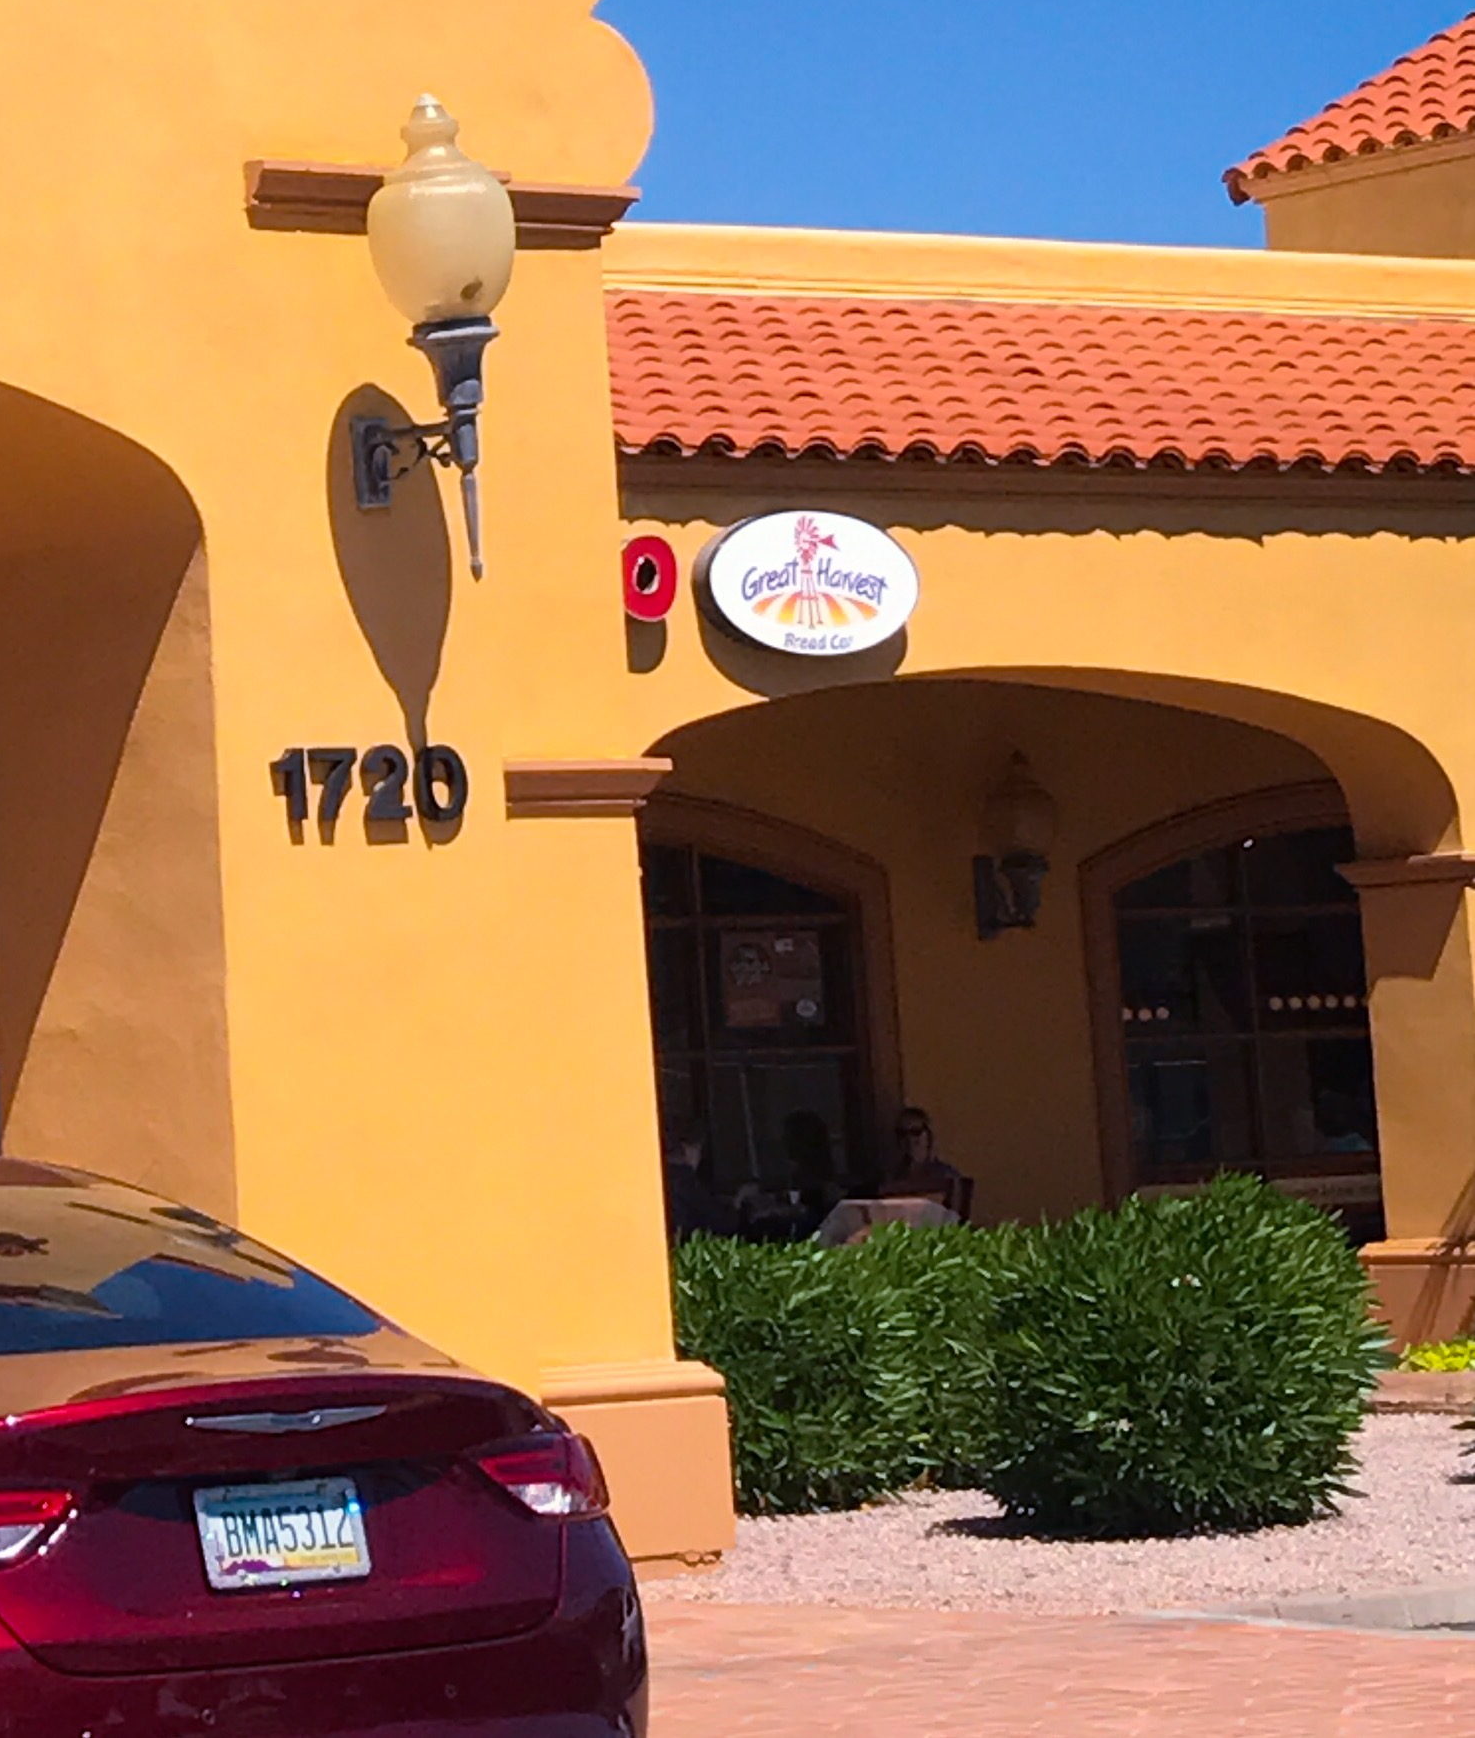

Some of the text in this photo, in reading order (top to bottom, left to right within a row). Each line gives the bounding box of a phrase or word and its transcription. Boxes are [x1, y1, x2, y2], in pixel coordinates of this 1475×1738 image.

[741, 557, 888, 605] Great Harvest
[783, 632, 826, 650] Bread
[270, 745, 468, 822] 1720
[224, 1504, 354, 1557] BMA5312
